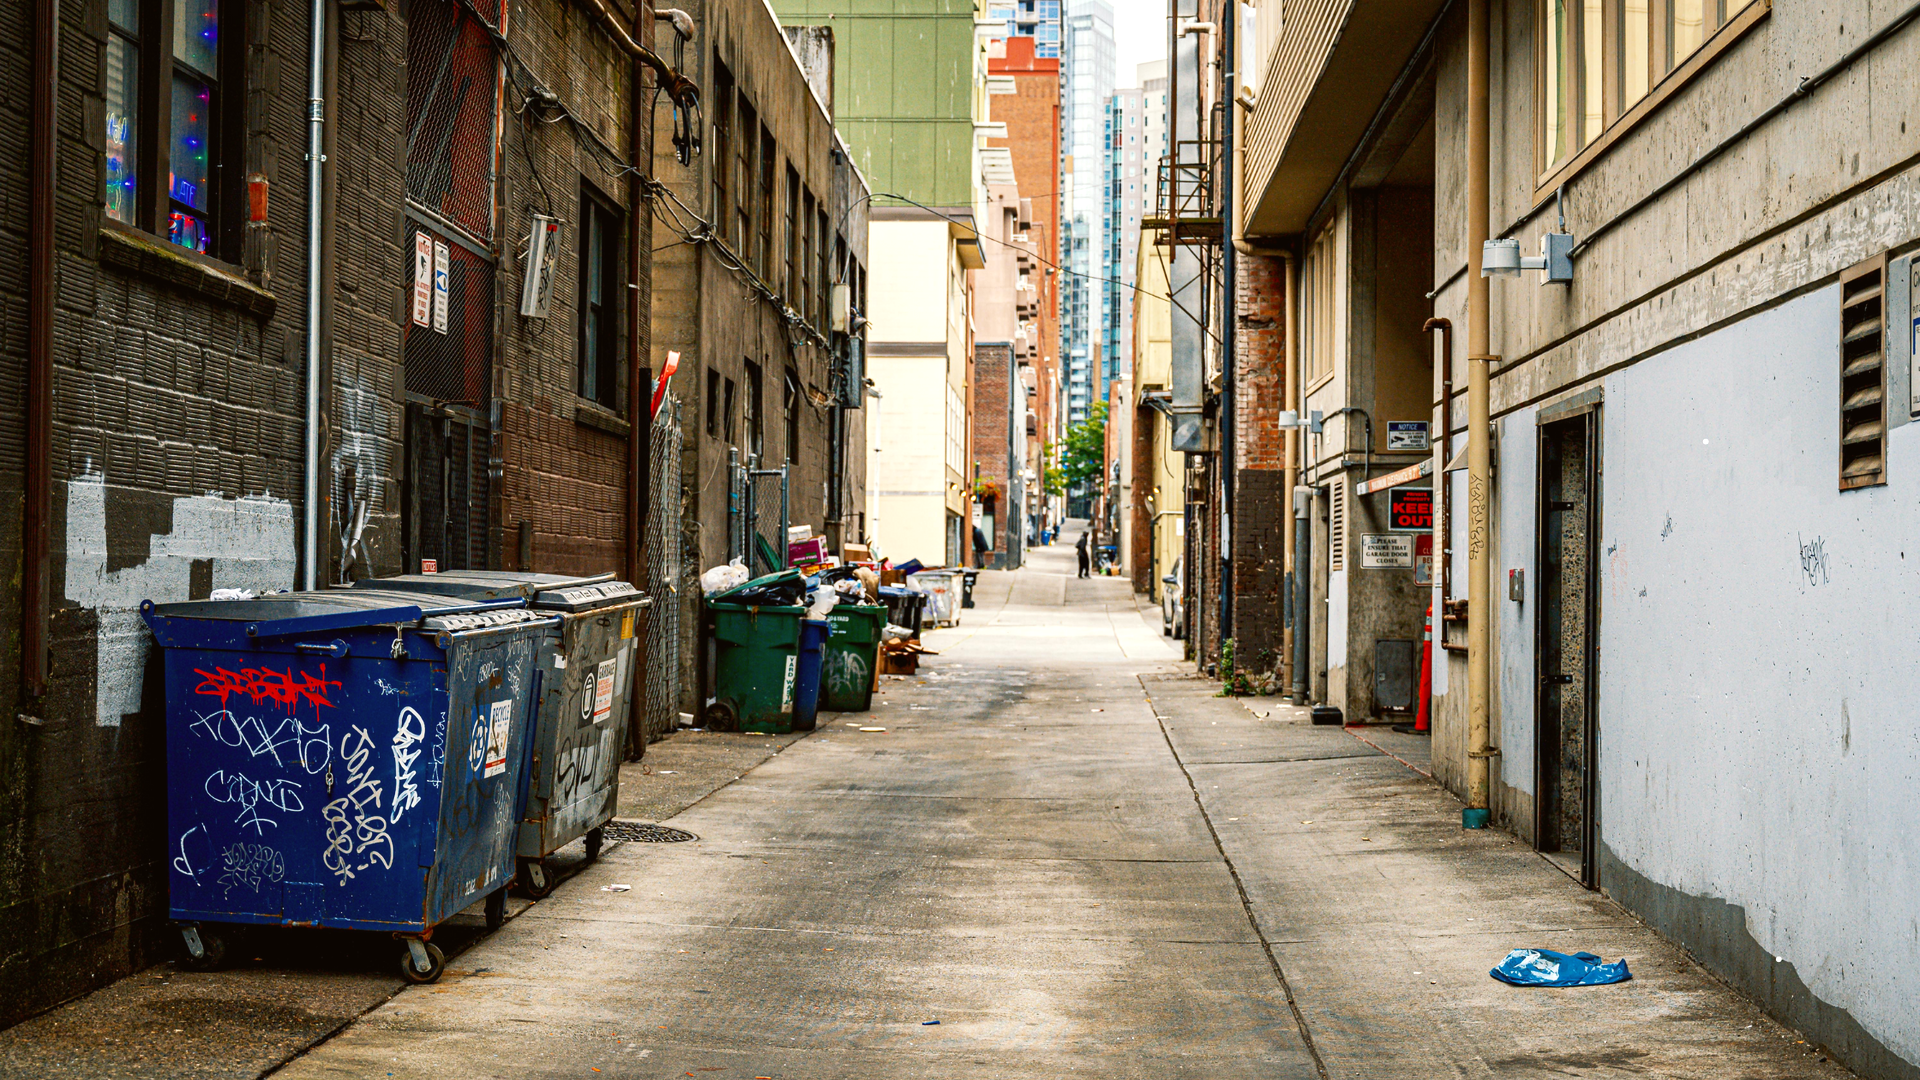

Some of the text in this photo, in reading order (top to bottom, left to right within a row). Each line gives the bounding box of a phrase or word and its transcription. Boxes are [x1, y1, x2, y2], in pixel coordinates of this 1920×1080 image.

[418, 240, 430, 256] NOTICE
[1398, 423, 1418, 431] NOTICE
[1398, 515, 1433, 526] OUT
[598, 661, 616, 679] GARBAGE
[493, 704, 510, 724] RECYCLE
